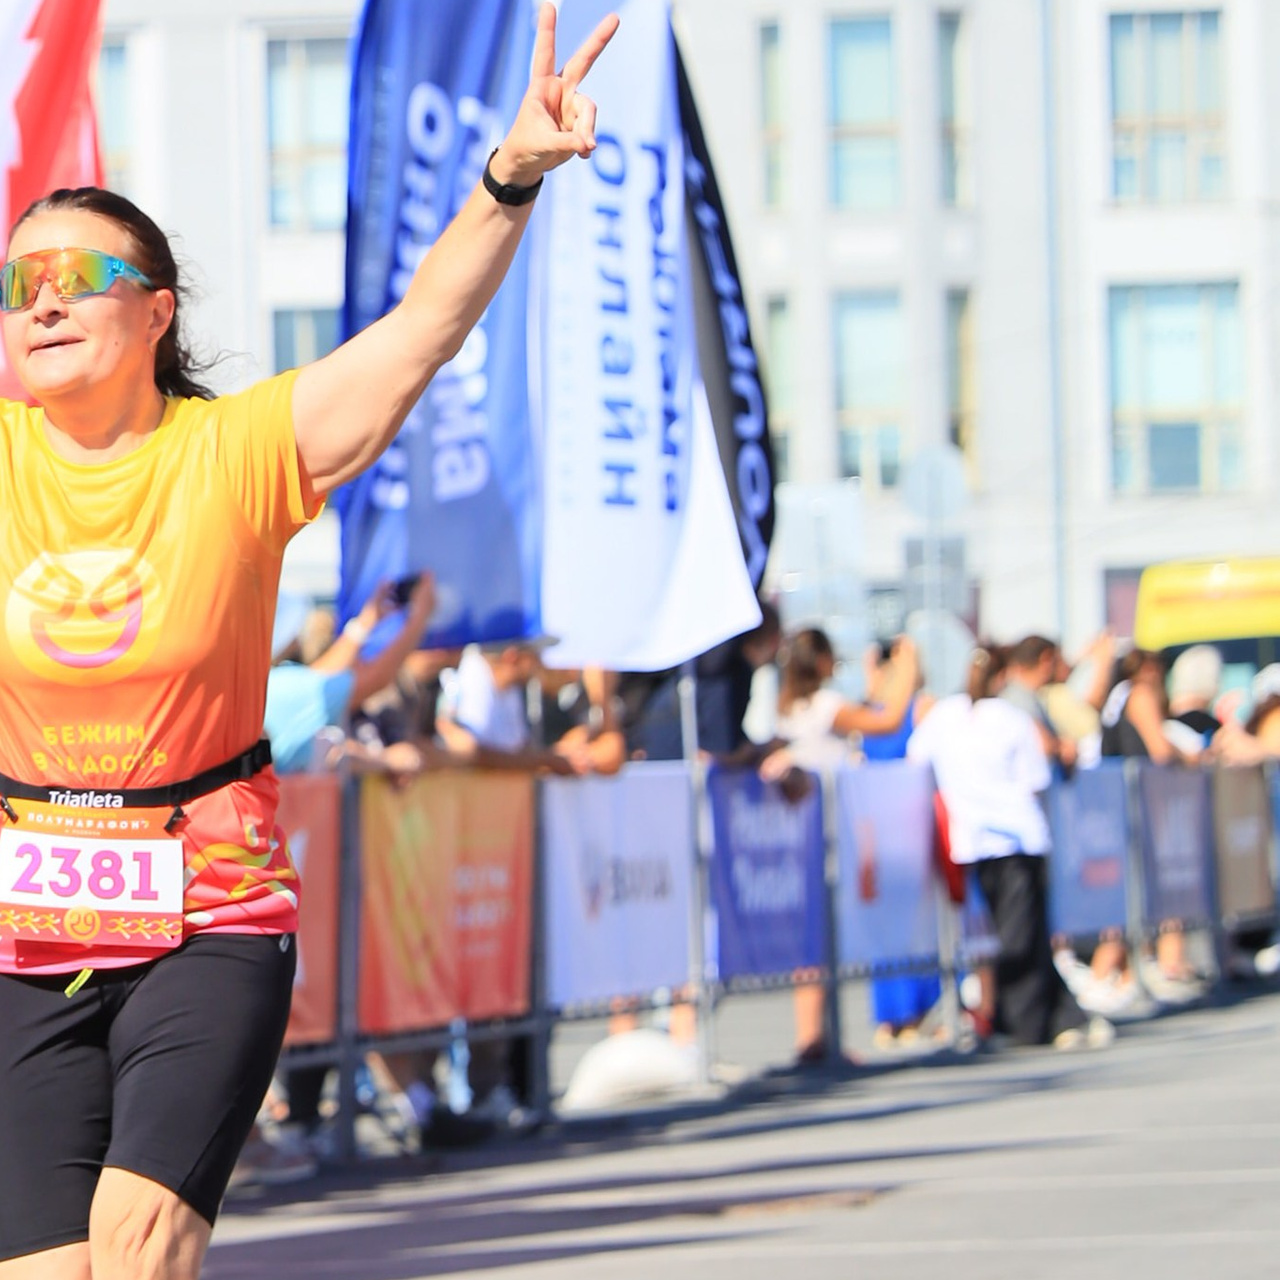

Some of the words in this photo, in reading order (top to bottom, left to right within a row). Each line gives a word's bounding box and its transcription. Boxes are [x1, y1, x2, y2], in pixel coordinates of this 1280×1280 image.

[592, 132, 648, 507] Онлайн
[42, 724, 146, 746] БЕЖИМ
[55, 747, 169, 776] ДОСЬ
[49, 790, 124, 808] Triatleta
[10, 842, 159, 901] 2381
